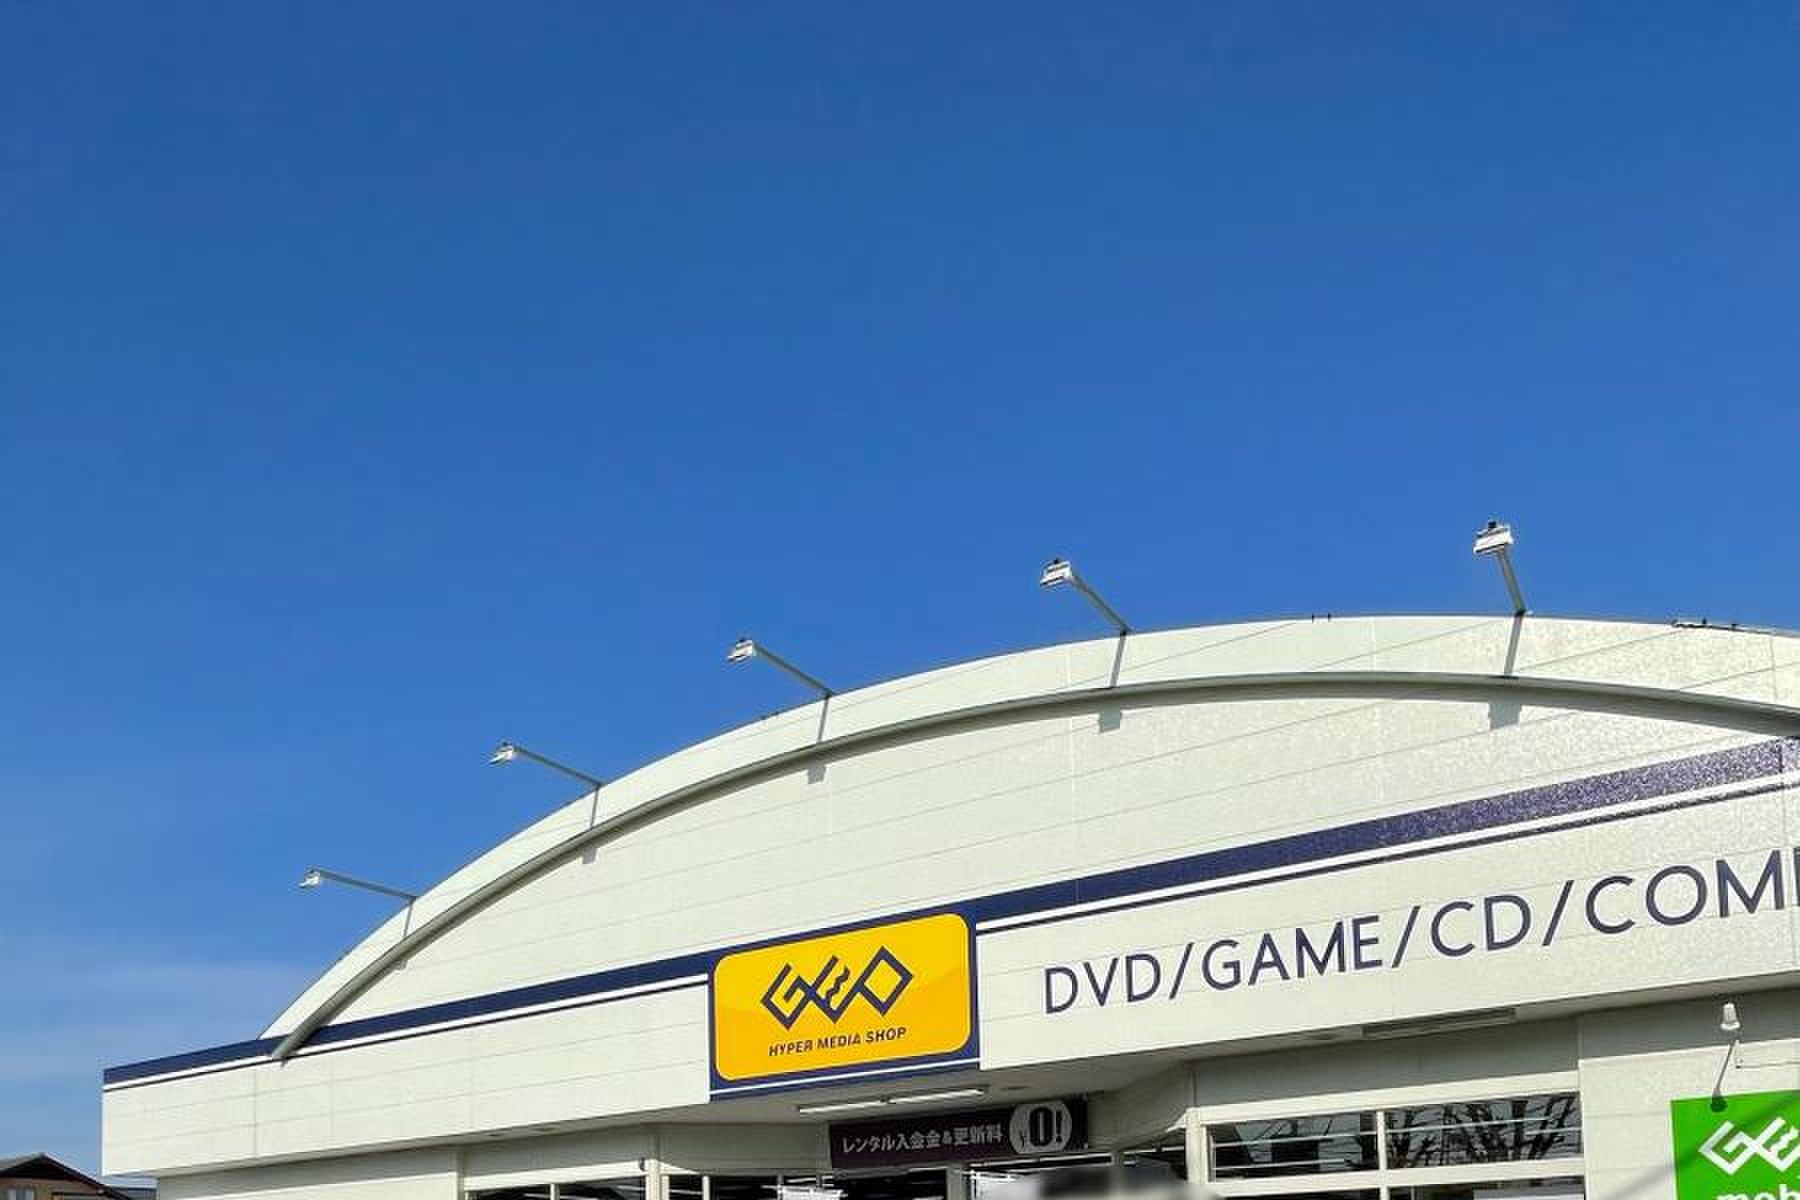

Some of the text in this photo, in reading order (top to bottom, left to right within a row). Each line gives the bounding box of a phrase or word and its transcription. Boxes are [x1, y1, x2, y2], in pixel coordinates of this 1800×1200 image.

[760, 946, 914, 1031] GEO
[768, 1027, 907, 1057] HYPER MEDIA SHOP
[1698, 1116, 1800, 1175] GE
